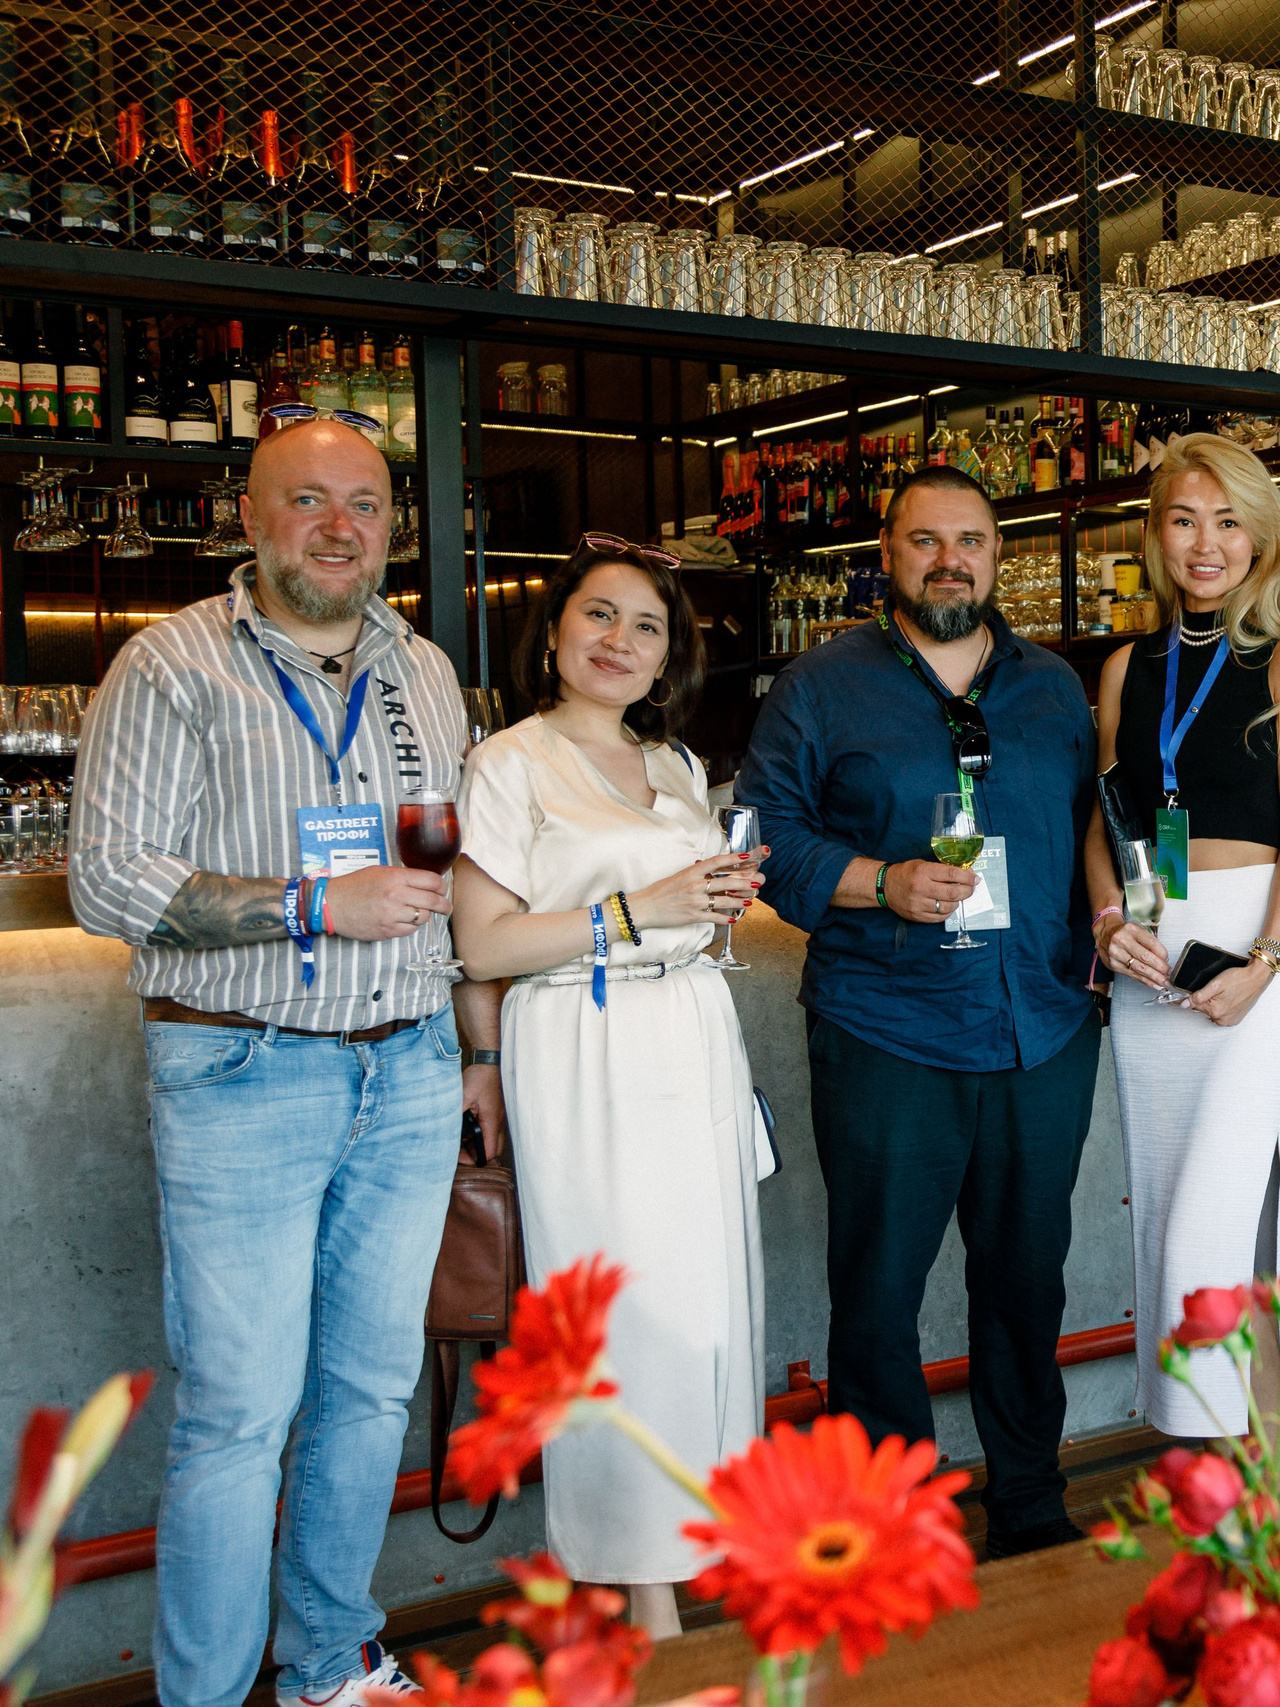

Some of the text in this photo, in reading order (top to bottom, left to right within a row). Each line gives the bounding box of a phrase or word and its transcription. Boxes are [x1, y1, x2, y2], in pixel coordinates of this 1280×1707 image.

[305, 816, 379, 831] GASTREET
[316, 829, 370, 842] ПРОФИ
[285, 889, 301, 936] ПРОФИ
[594, 924, 606, 956] ПРОФИ
